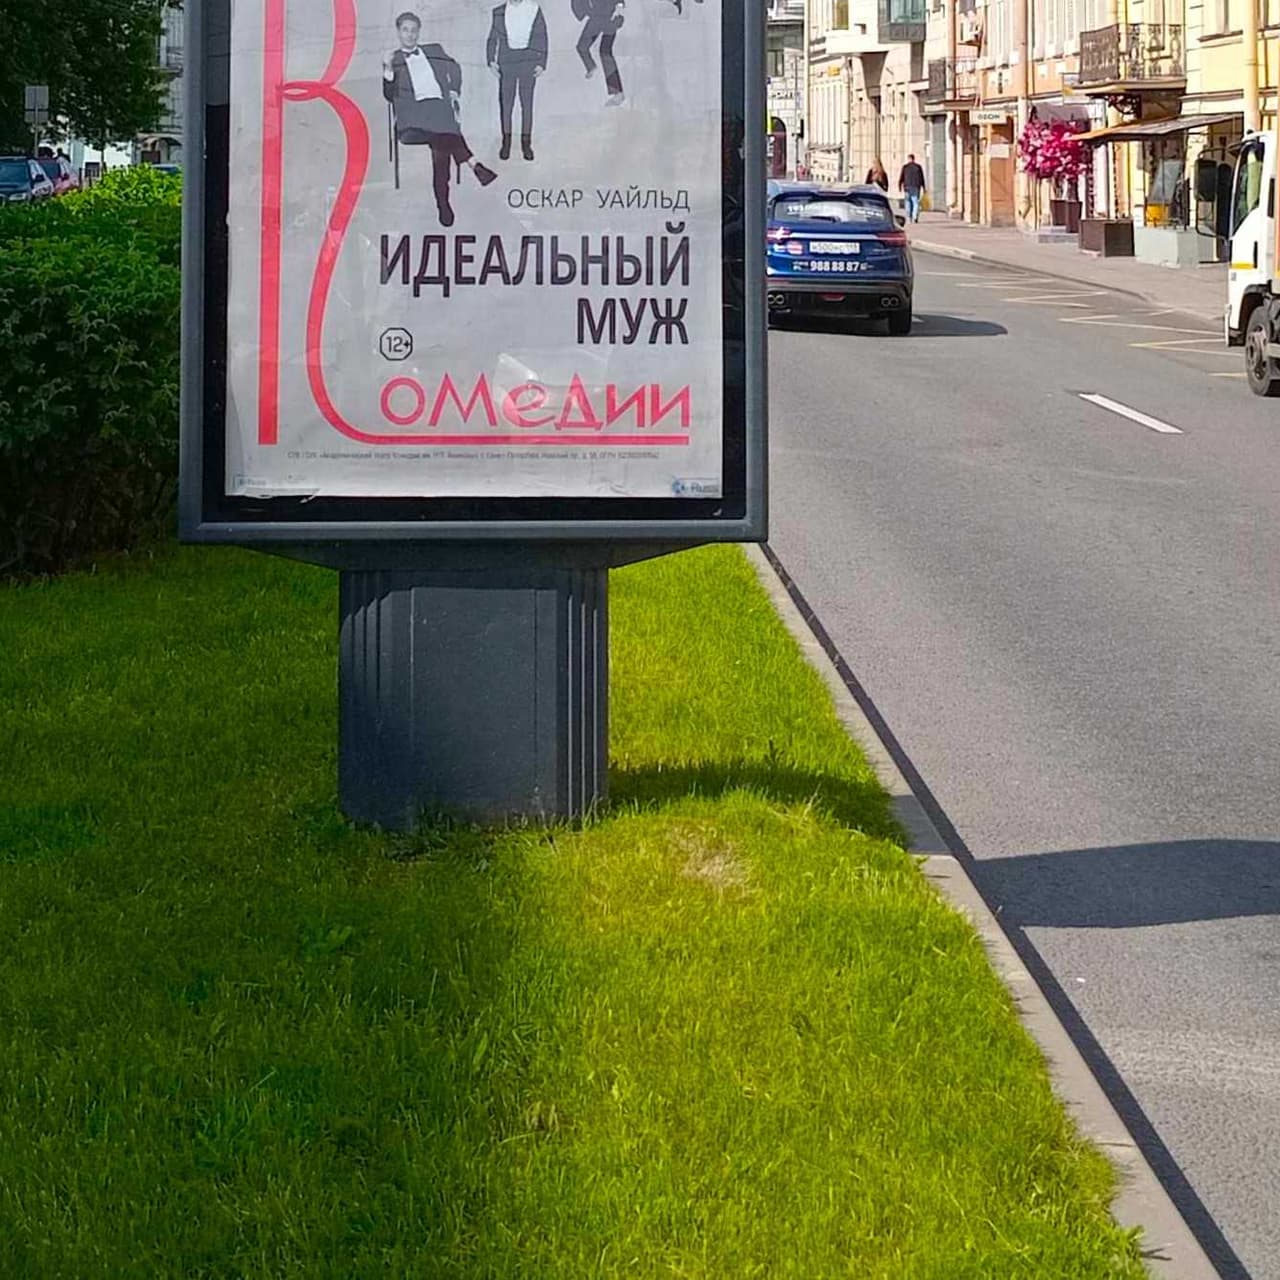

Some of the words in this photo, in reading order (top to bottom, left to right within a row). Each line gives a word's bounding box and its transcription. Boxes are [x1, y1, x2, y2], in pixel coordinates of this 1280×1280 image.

[507, 188, 584, 209] ОСКАР
[596, 186, 691, 213] УАЙЛЬД
[379, 221, 690, 298] ИДЕАЛЬНЫЙ
[576, 297, 690, 345] МУЖ
[385, 335, 412, 353] 12+
